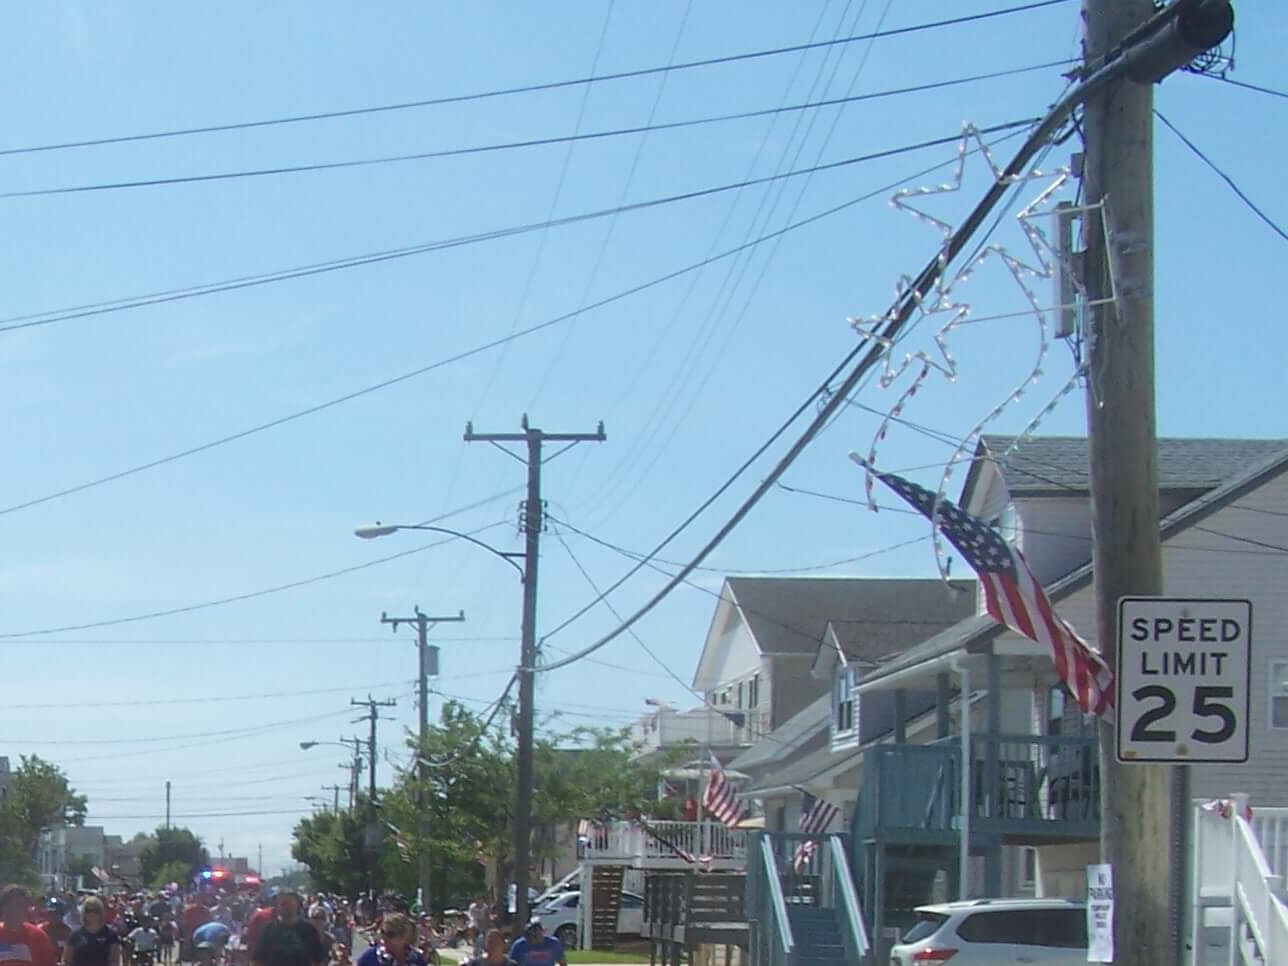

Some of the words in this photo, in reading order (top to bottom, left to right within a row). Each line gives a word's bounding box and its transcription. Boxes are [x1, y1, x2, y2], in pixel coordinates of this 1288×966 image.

[1131, 618, 1241, 642] SPEED
[1141, 652, 1228, 676] LIMIT
[1130, 685, 1237, 744] 25
